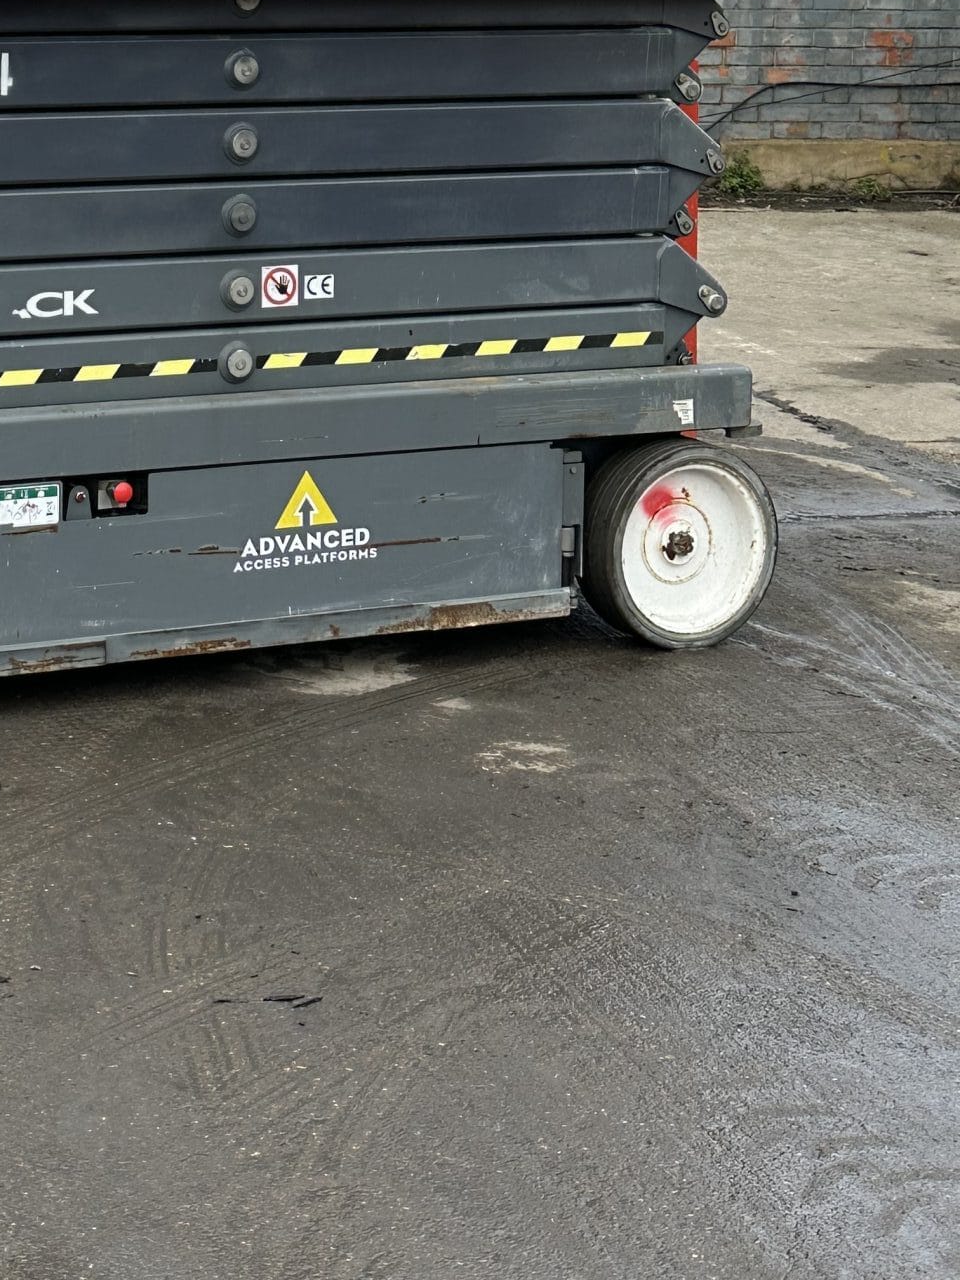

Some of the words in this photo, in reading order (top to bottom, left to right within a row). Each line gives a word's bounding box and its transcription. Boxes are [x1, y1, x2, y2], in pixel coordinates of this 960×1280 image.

[307, 275, 332, 295] CE
[241, 527, 370, 558] ADVANCED
[233, 556, 290, 573] ACCESS
[294, 547, 378, 566] PLATFORMS
